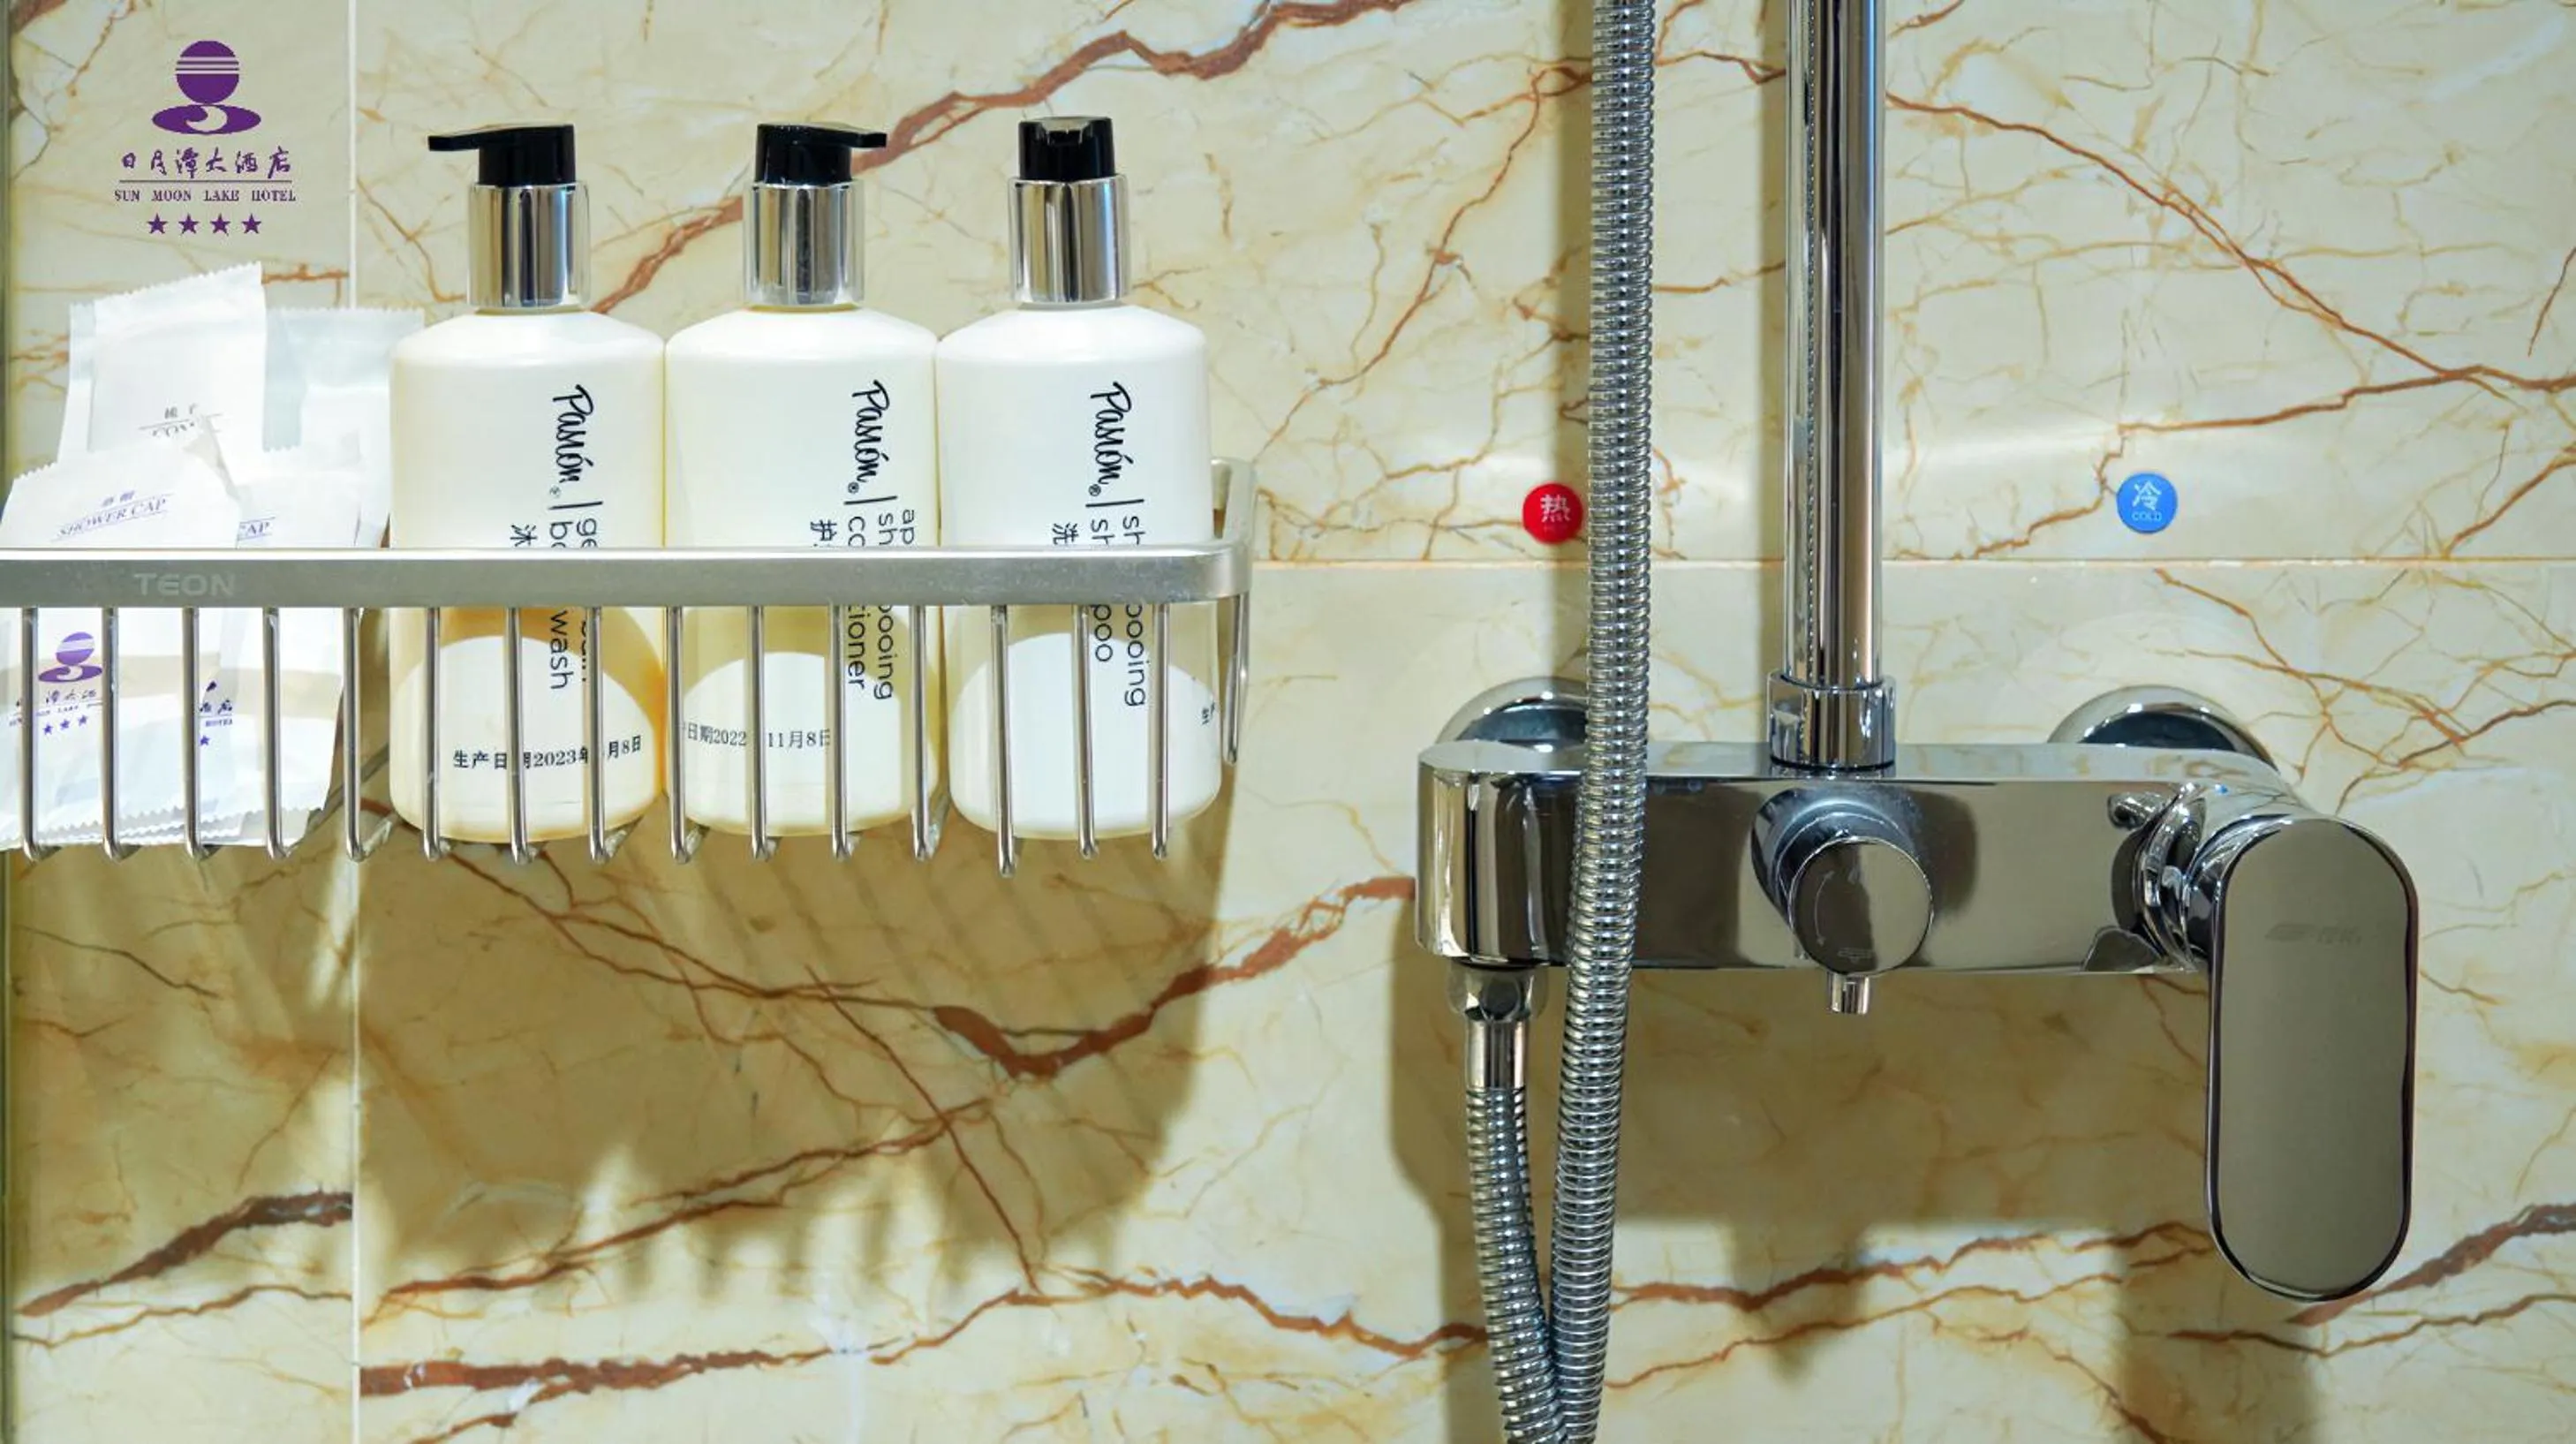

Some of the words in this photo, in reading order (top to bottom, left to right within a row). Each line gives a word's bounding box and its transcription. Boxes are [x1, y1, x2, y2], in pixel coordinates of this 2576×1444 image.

[1539, 494, 1571, 523] 热
[2132, 480, 2162, 510] 冷
[133, 573, 237, 597] TEON
[549, 610, 575, 690] wash
